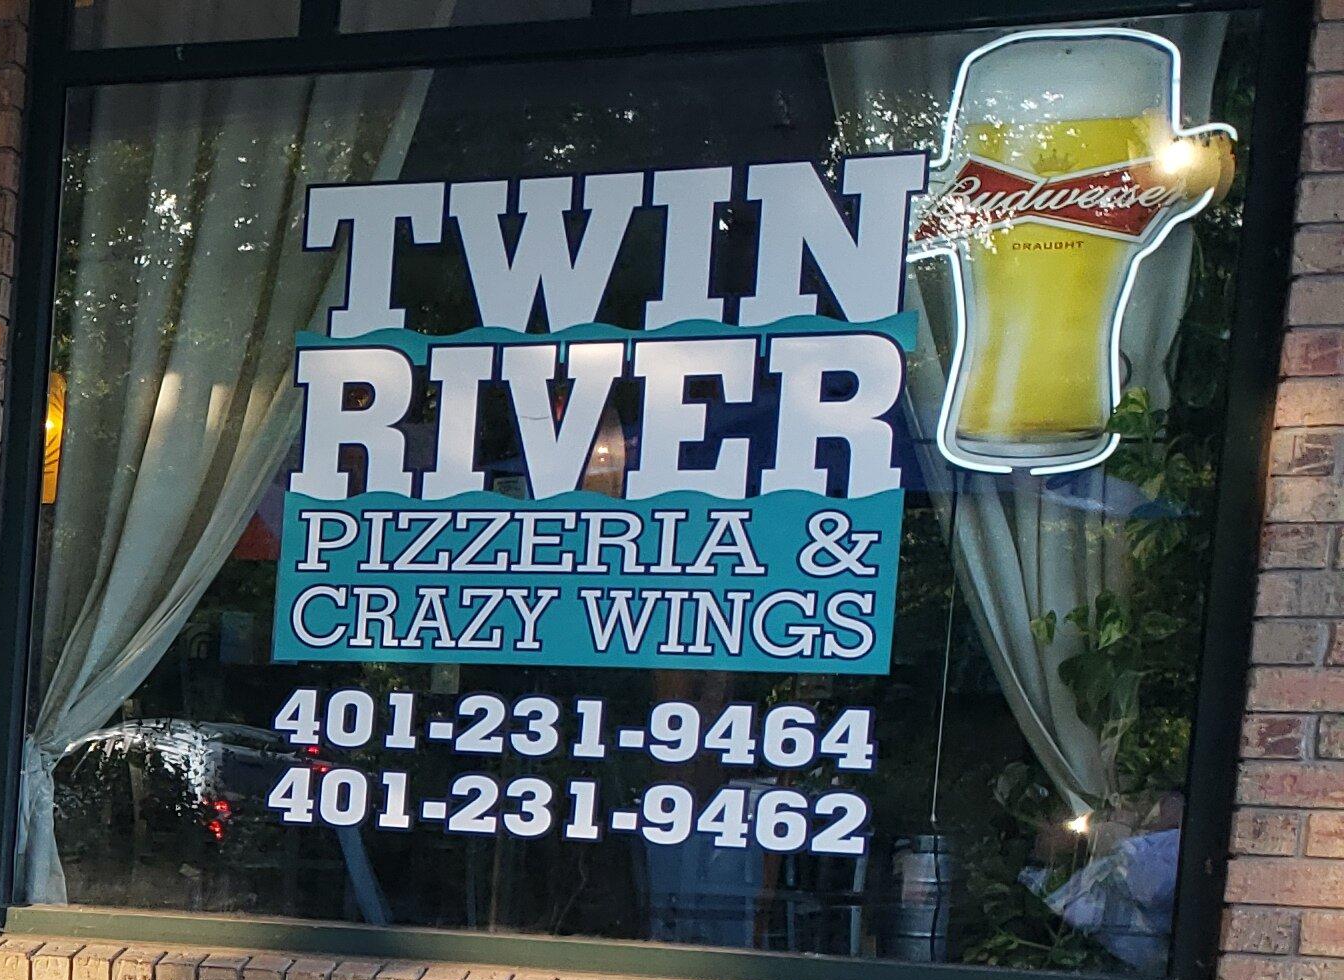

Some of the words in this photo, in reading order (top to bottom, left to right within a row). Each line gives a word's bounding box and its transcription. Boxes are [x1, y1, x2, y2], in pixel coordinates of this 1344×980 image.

[920, 174, 1184, 219] Budweiser
[305, 150, 930, 338] TWIN
[1011, 240, 1085, 251] DRAUGHT
[288, 333, 904, 498] RIVER
[296, 508, 767, 577] PIZZERIA
[798, 508, 880, 579] &
[289, 583, 559, 651] CRAZY
[580, 588, 876, 661] WINGS
[273, 688, 876, 770] 401-231-9464
[266, 765, 871, 856] 401-231-9462
